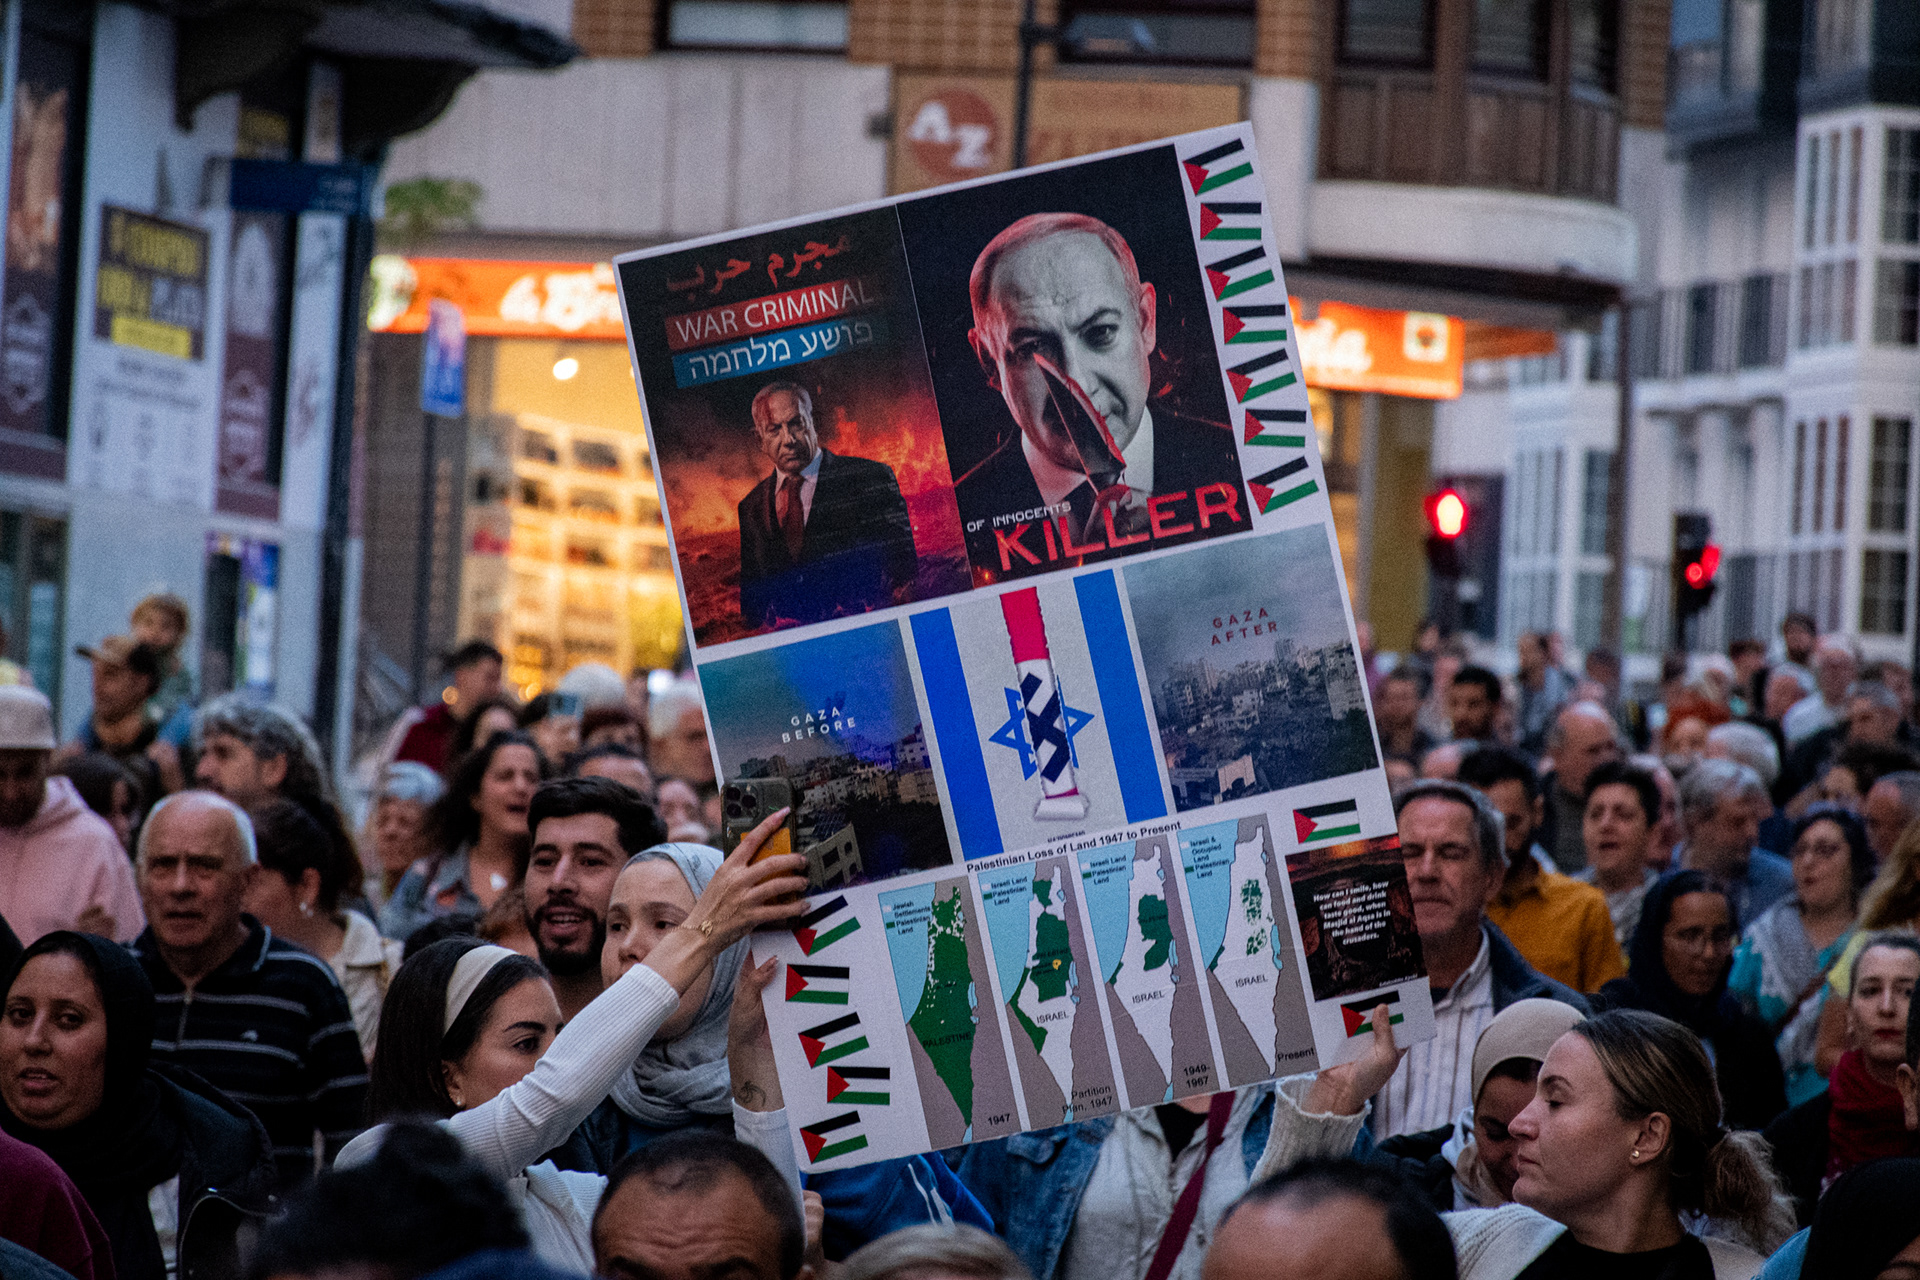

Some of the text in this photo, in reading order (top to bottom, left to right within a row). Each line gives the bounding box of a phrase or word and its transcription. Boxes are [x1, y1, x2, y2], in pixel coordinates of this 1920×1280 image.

[767, 235, 848, 289] مجرم
[667, 258, 751, 301] حرب
[675, 280, 874, 343] WAR CRIMINAL
[689, 320, 874, 379] פושע מלחמה
[967, 501, 1072, 533] OF INNOCENTS
[992, 482, 1242, 571] KILLER
[1212, 607, 1269, 628] GAZA
[1211, 621, 1278, 646] AFTER
[791, 706, 841, 726] GAZA
[781, 717, 856, 744] BEFORE
[967, 853, 1025, 873] Palestinian
[1027, 849, 1054, 861] Loss
[1056, 843, 1068, 855] of
[1070, 838, 1097, 852] Land
[1099, 832, 1123, 845] 1947
[1126, 830, 1137, 840] to
[1140, 821, 1182, 837] Present
[1191, 843, 1222, 855] Occupied
[1090, 855, 1127, 868] Israeli Land
[1193, 854, 1210, 863] Land
[1195, 858, 1230, 870] Palestinian
[1091, 865, 1127, 877] Palestinian
[1196, 869, 1213, 879] Land
[991, 876, 1027, 889] Israeli Land
[1093, 876, 1109, 885] Land
[992, 885, 1027, 897] Palestinian
[1313, 893, 1330, 902] How
[1332, 890, 1344, 898] can
[1350, 884, 1371, 894] smile,
[1372, 881, 1389, 890] how
[893, 900, 914, 910] Jewish
[993, 896, 1010, 906] Land
[1319, 890, 1387, 911] can food and drink
[894, 906, 931, 918] Settlements
[1324, 901, 1386, 919] taste good, when
[896, 916, 931, 927] Palestinian
[1323, 918, 1348, 930] Masjid
[1357, 913, 1375, 923] Aqsa
[1376, 911, 1382, 919] is
[1383, 909, 1391, 917] in
[897, 927, 913, 935] Land
[1332, 921, 1386, 937] the hand of the
[1342, 932, 1380, 945] crusaders.
[1235, 974, 1268, 988] ISRAEL
[1132, 990, 1165, 1004] ISRAEL
[1036, 1011, 1069, 1024] ISRAEL
[922, 1031, 973, 1048] PALESTINE
[1277, 1047, 1315, 1062] Present
[1183, 1064, 1210, 1077] 1949-
[1186, 1076, 1209, 1089] 1967
[1071, 1085, 1111, 1100] Partition
[1062, 1096, 1113, 1115] Plan, 1947
[987, 1113, 1011, 1126] 1947
